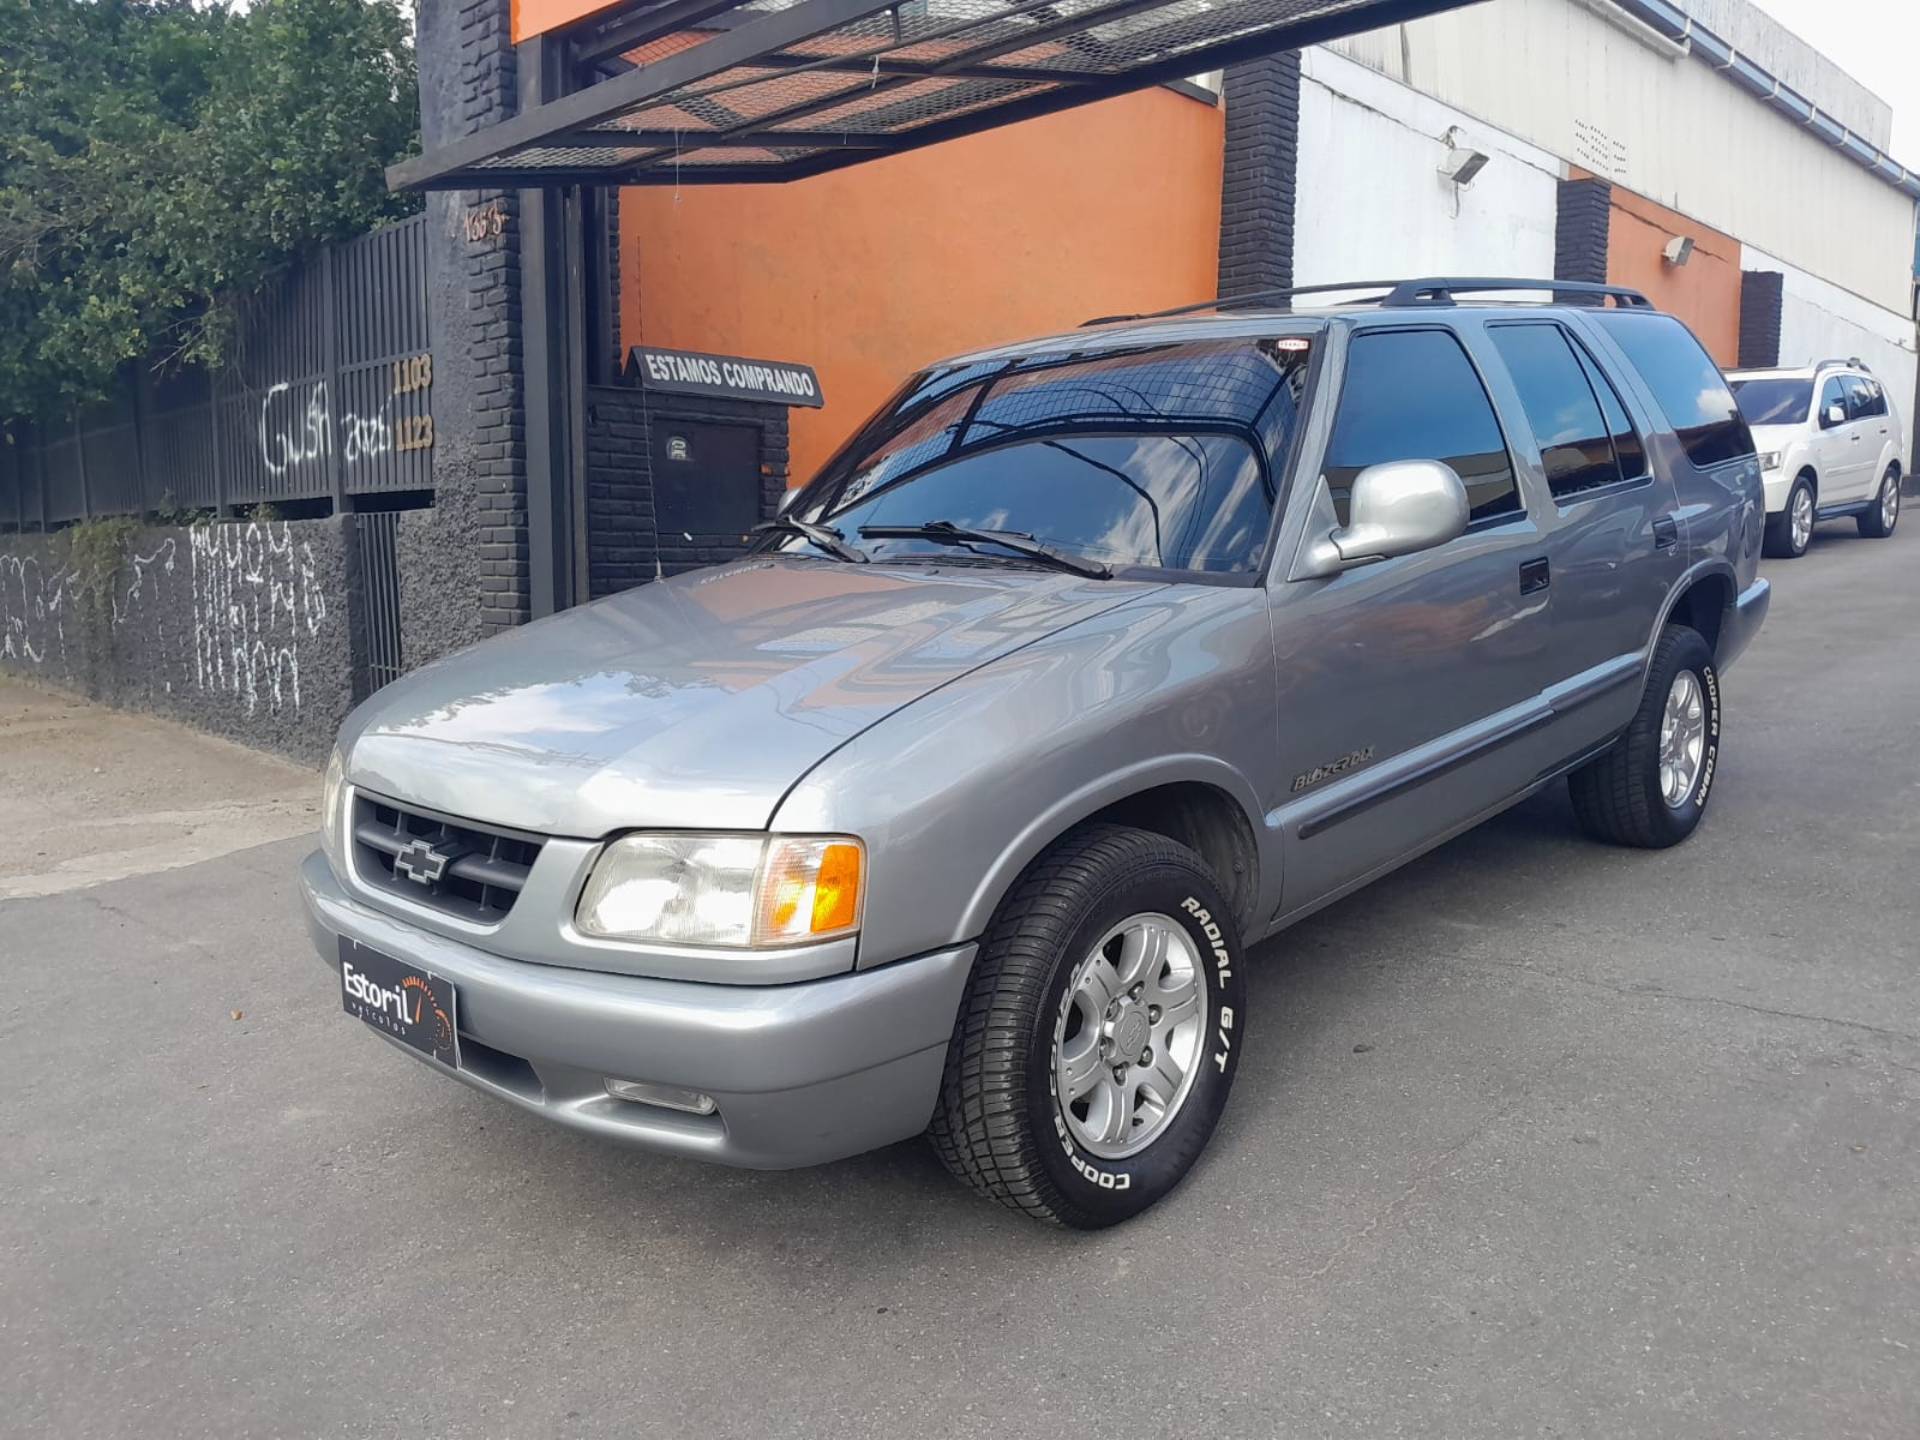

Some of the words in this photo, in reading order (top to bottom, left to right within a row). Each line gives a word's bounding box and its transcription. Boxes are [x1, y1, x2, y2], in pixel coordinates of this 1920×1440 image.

[394, 353, 431, 394] 1103
[645, 354, 722, 385] ESTAMOS
[723, 362, 815, 396] COMPRANDO
[395, 415, 433, 451] 1123
[1703, 666, 1718, 736] COOPER
[1695, 745, 1716, 806] COBRA
[343, 961, 413, 1025] Estoril
[1180, 896, 1233, 989] RADIAL
[1214, 1006, 1234, 1073] G/T
[1053, 1114, 1130, 1190] COOPER
